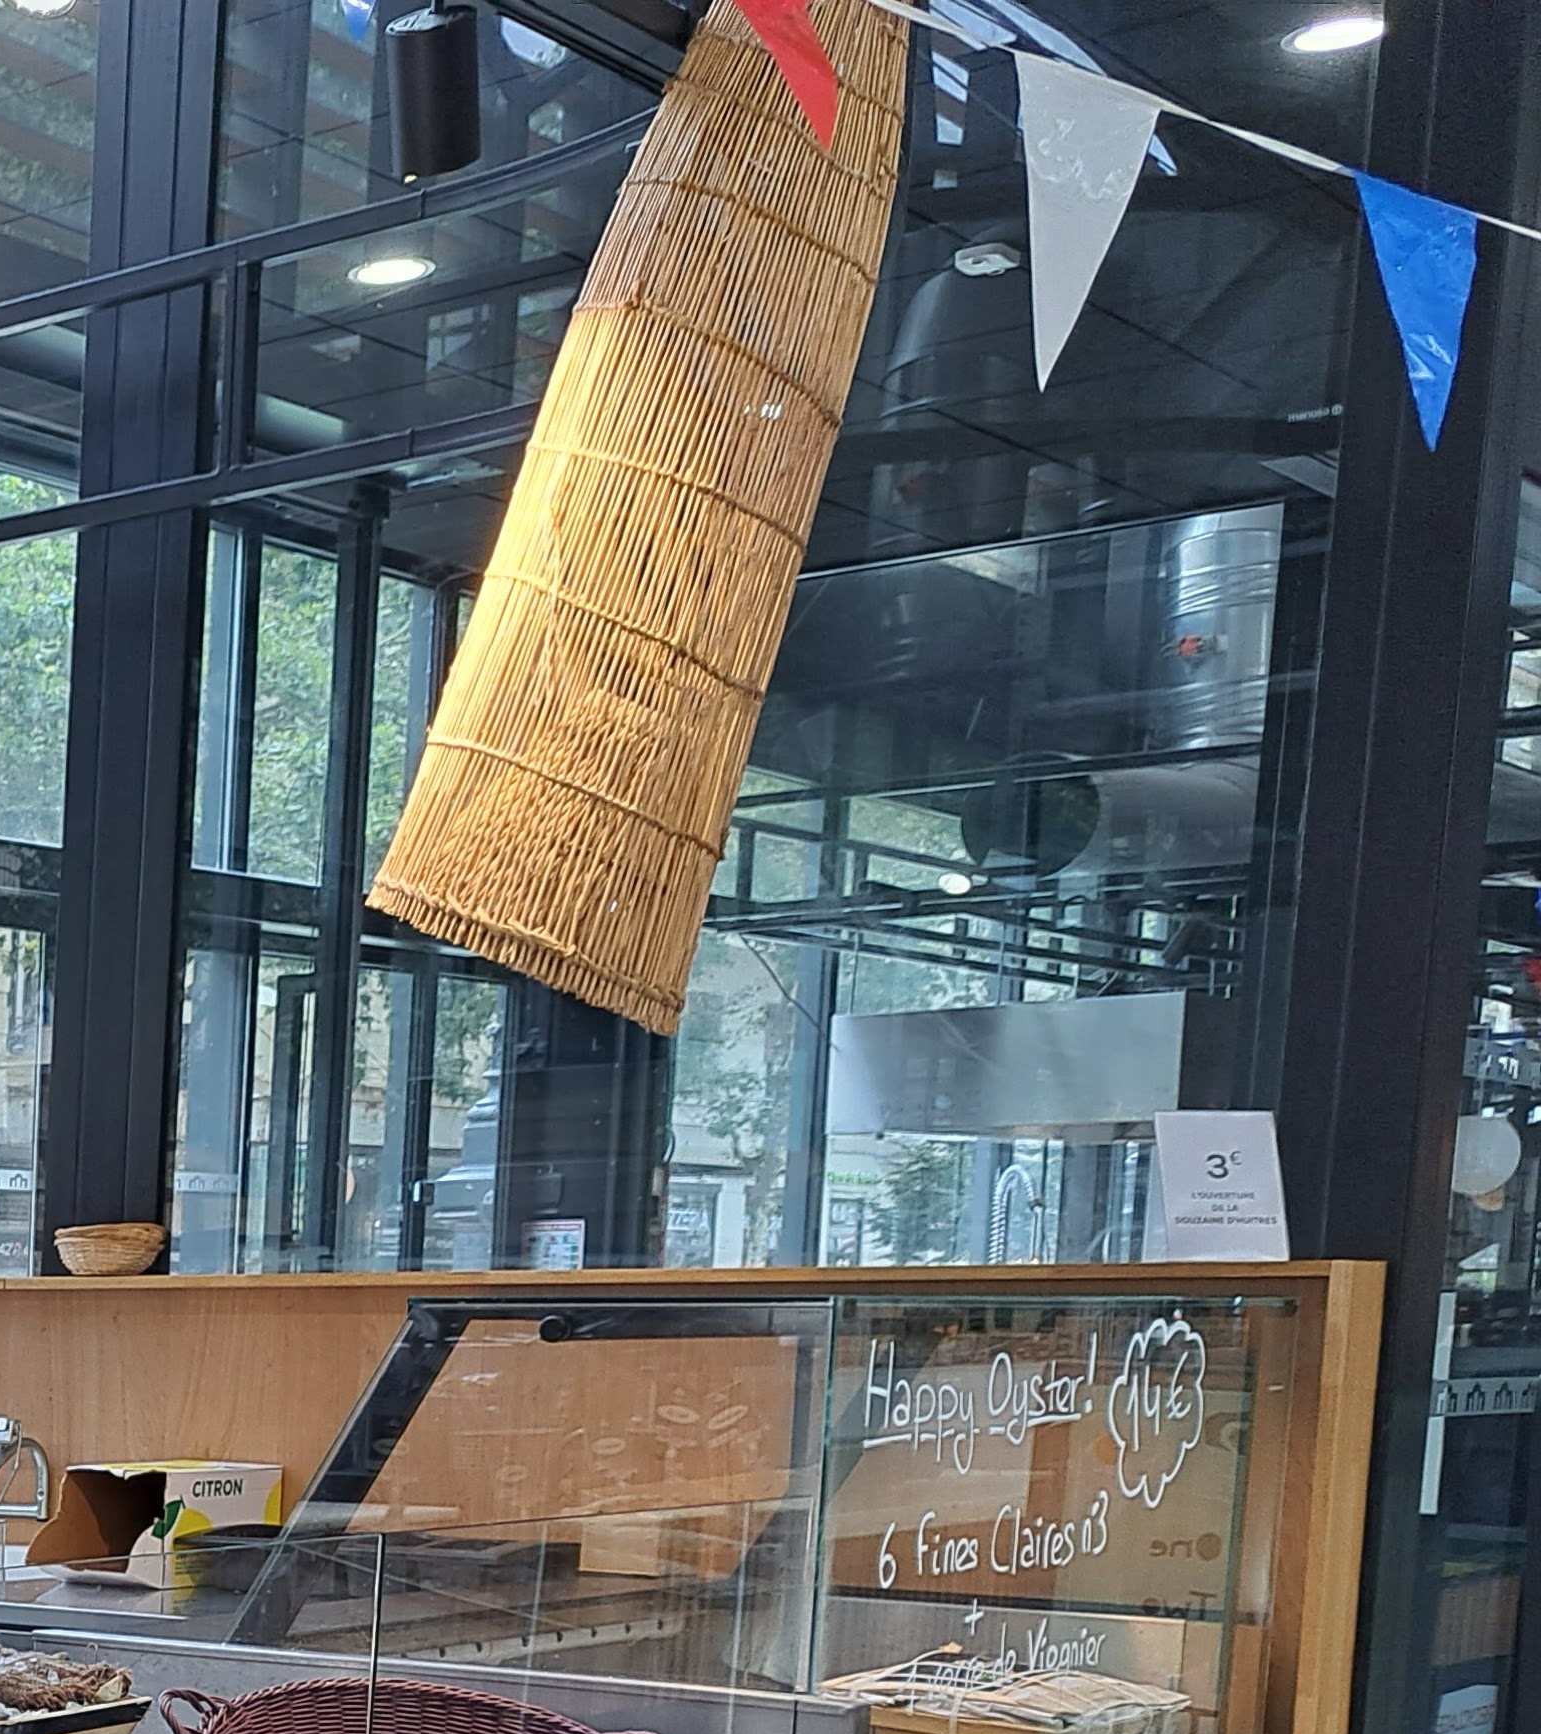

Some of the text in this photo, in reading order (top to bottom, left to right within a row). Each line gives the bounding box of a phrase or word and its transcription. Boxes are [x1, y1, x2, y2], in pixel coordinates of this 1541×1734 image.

[1205, 1150, 1243, 1180] 3€
[863, 1331, 1098, 1475] Happy Oyster!
[191, 1478, 244, 1499] CITRON
[878, 1520, 898, 1590] 6
[989, 1503, 1076, 1577] Claires
[1027, 1616, 1108, 1673] Viognier
